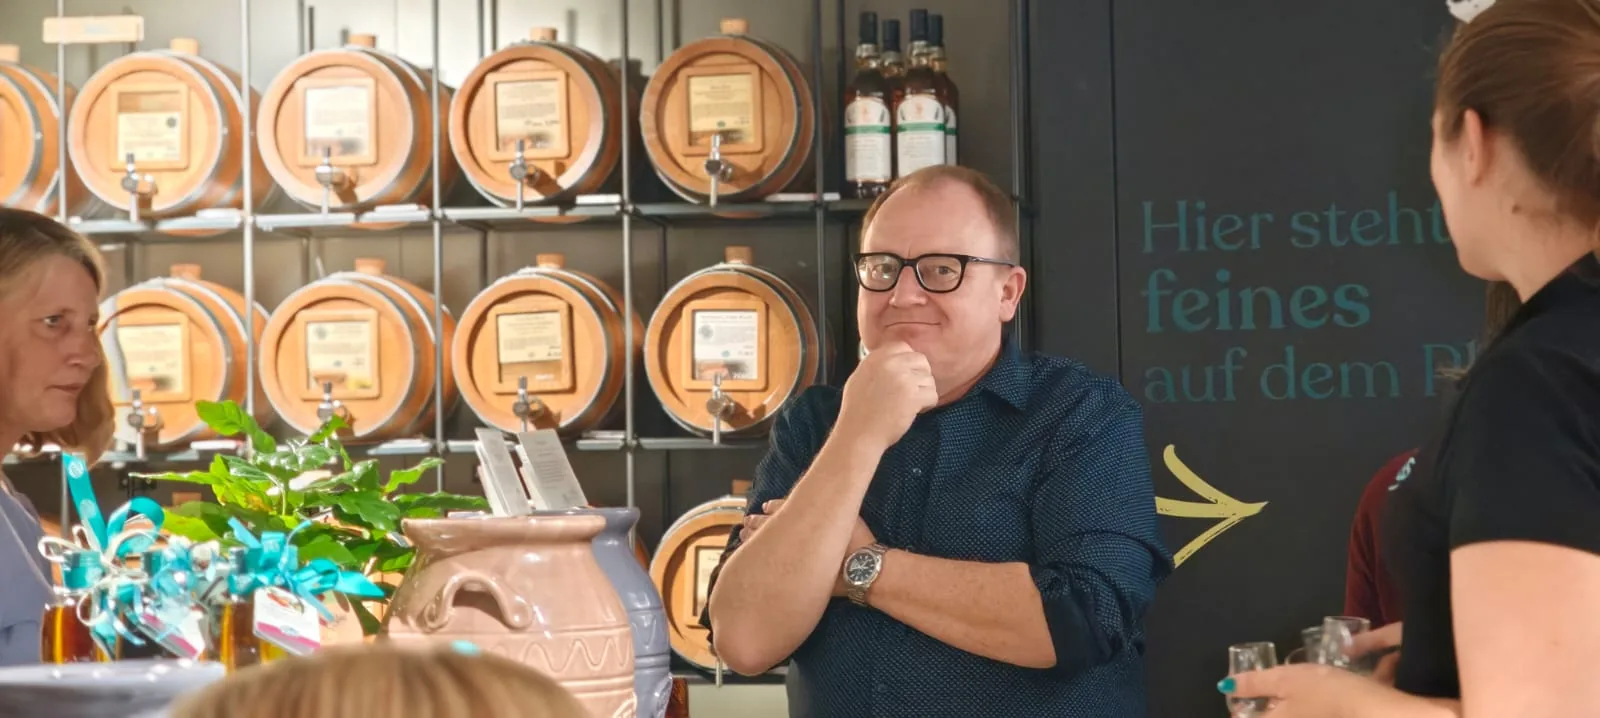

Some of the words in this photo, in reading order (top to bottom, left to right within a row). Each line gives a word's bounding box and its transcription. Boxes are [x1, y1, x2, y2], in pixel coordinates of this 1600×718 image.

[1142, 200, 1273, 252] Hier
[1290, 191, 1451, 247] steht
[1141, 269, 1371, 332] feines
[1144, 347, 1248, 403] auf
[1260, 346, 1401, 400] dem
